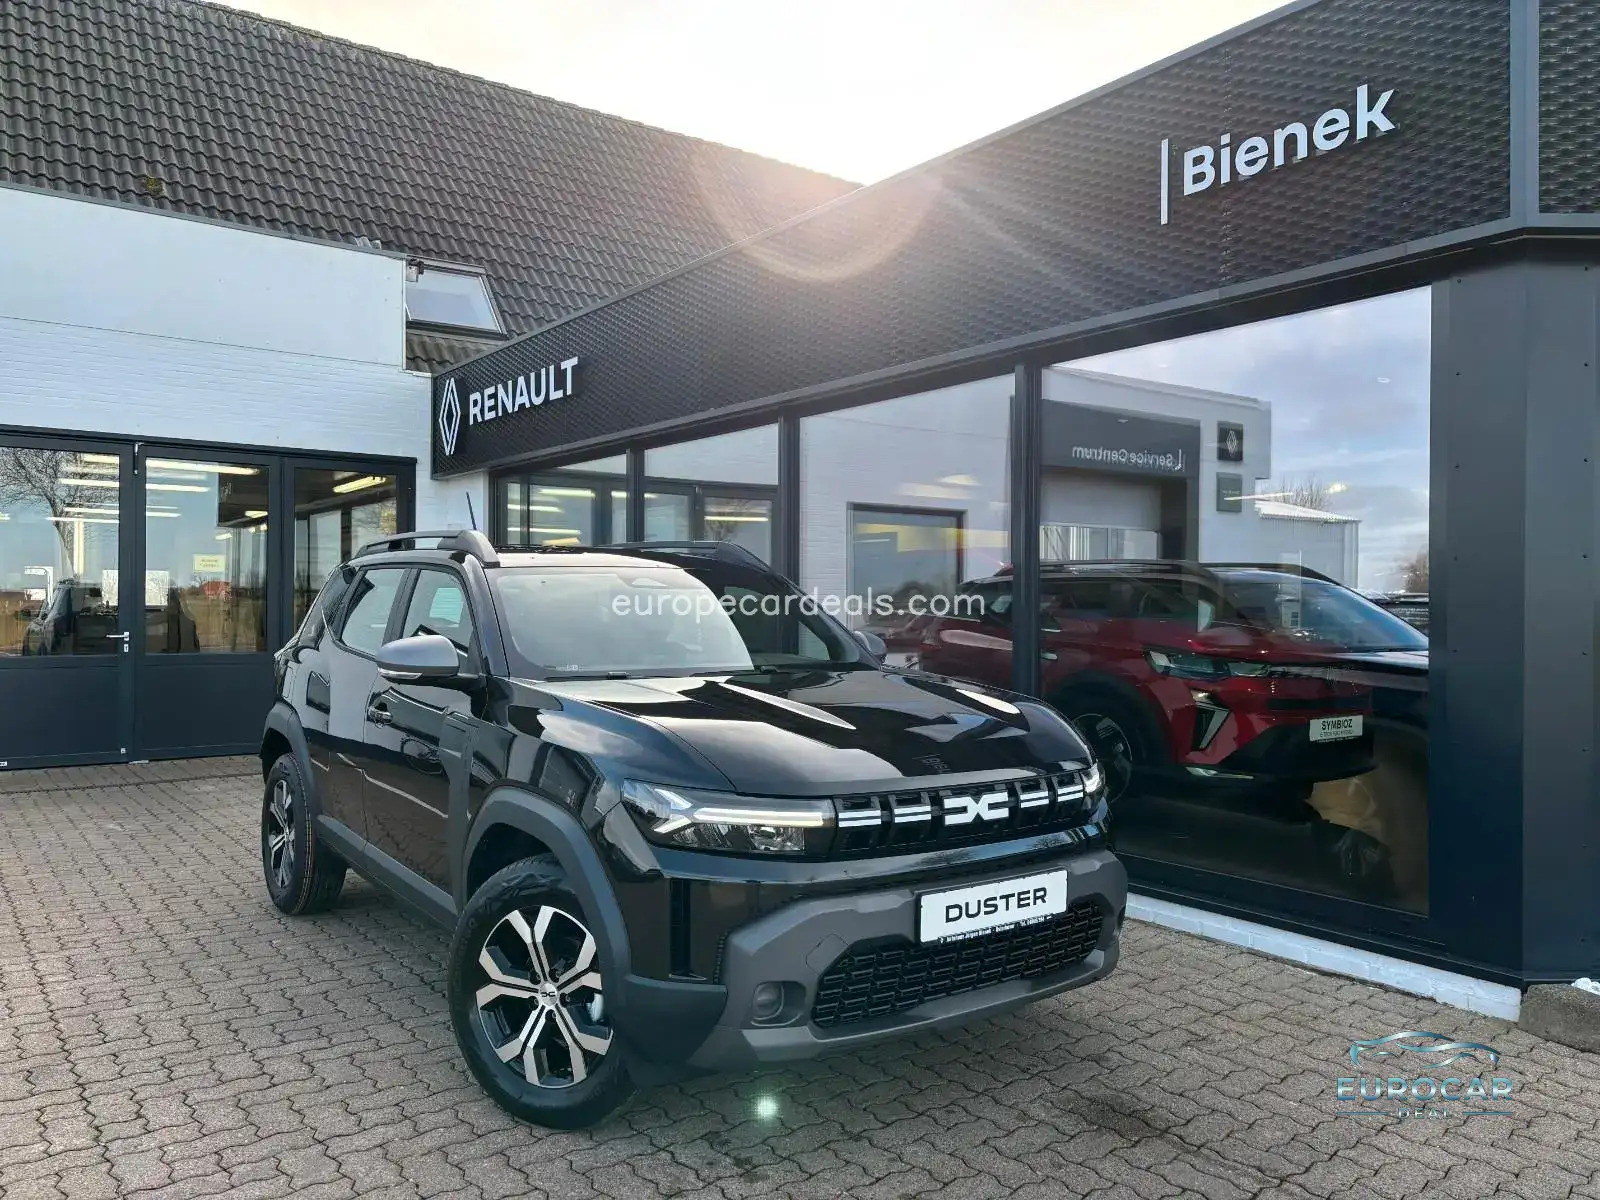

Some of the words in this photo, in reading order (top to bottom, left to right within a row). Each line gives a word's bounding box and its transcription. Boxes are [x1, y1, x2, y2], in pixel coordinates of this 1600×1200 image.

[1183, 84, 1396, 196] Bienek
[469, 356, 579, 426] RENAULT
[1321, 719, 1353, 730] SYMBIOZ
[945, 886, 1048, 924] DUSTER
